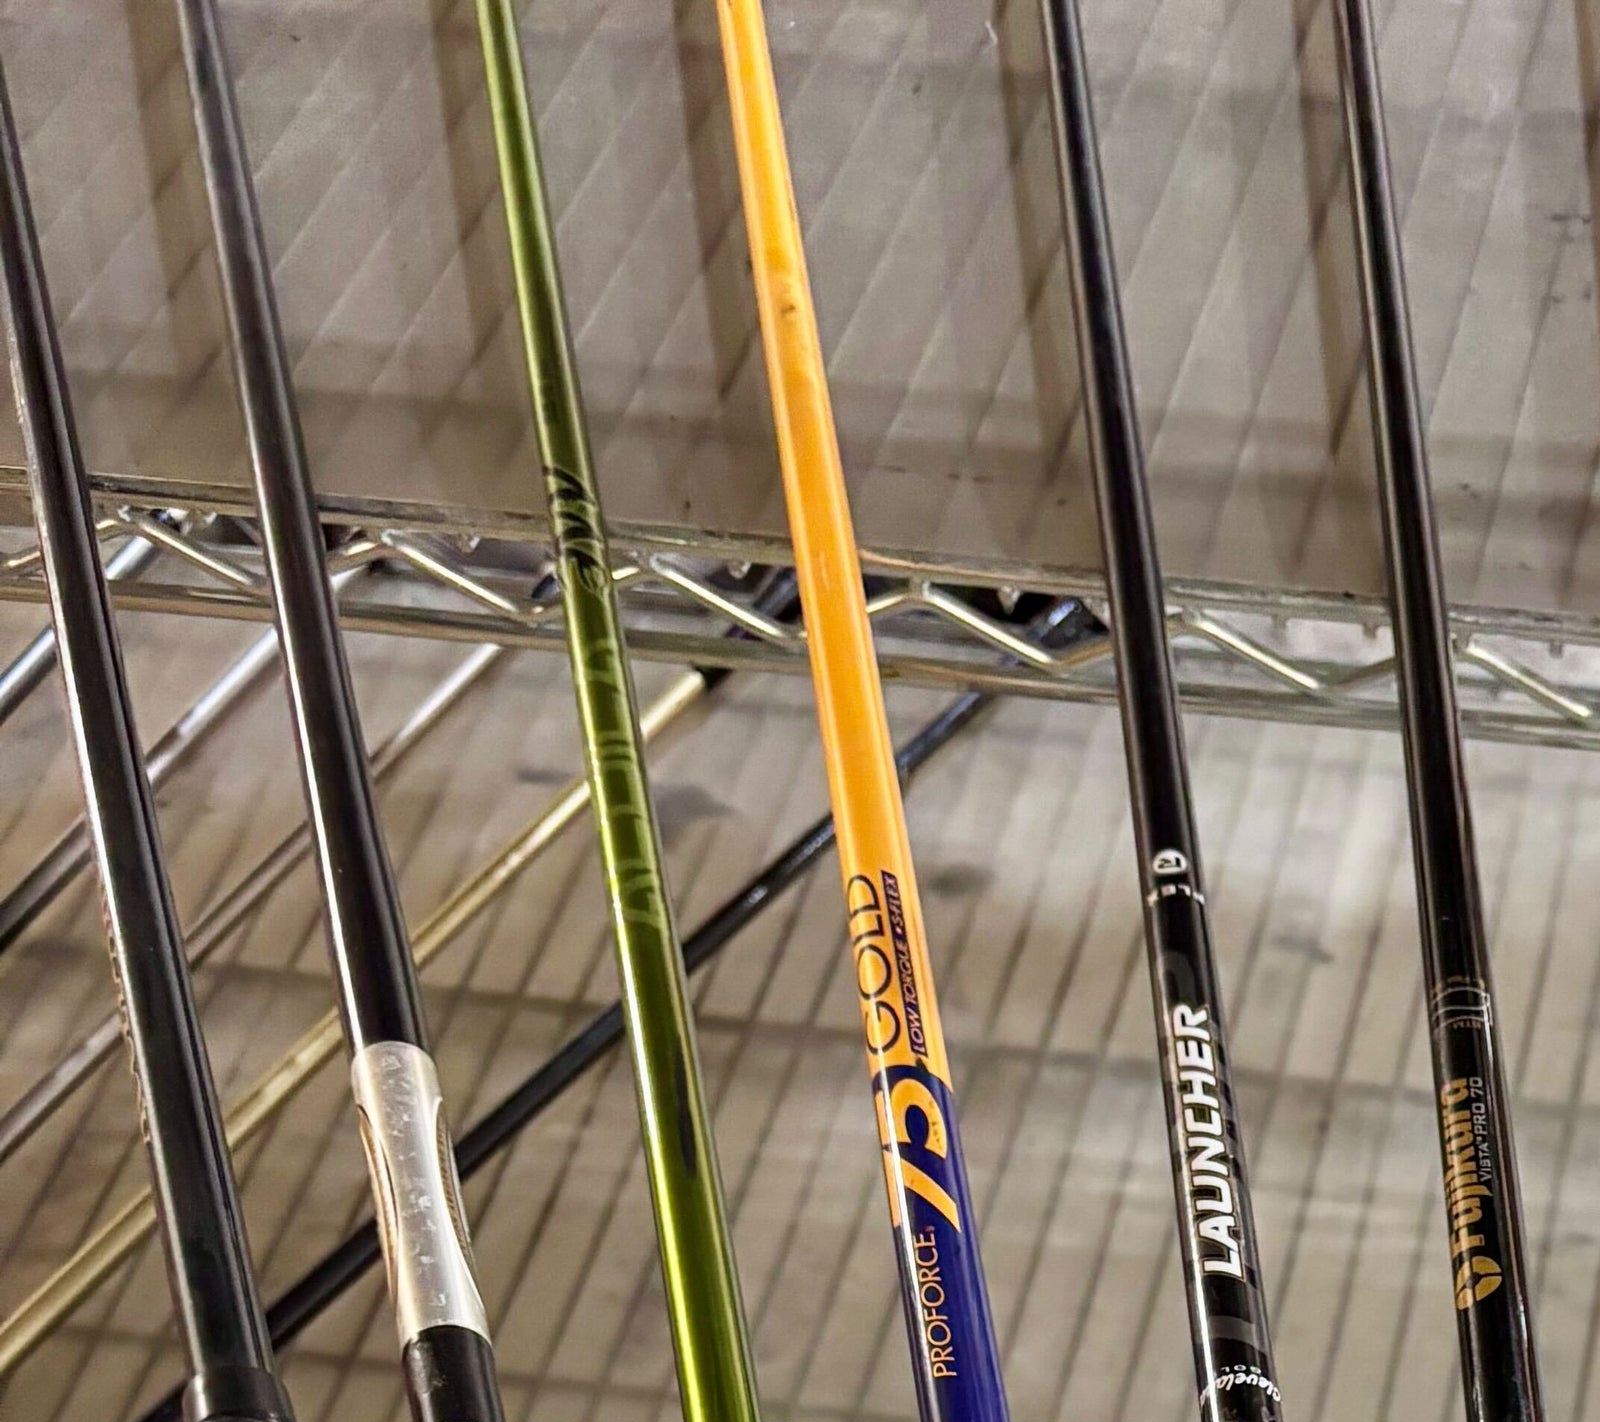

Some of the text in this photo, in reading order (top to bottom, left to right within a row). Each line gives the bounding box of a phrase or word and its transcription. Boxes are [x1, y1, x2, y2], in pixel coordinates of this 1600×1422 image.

[848, 874, 901, 1056] GOLD
[906, 1005, 927, 1055] LOW
[1171, 1003, 1245, 1281] LAUNCHER
[1469, 1076, 1485, 1099] 70
[1471, 1102, 1488, 1136] PRO
[1439, 1077, 1493, 1253] Fujikura
[911, 1230, 958, 1379] PROFORCE
